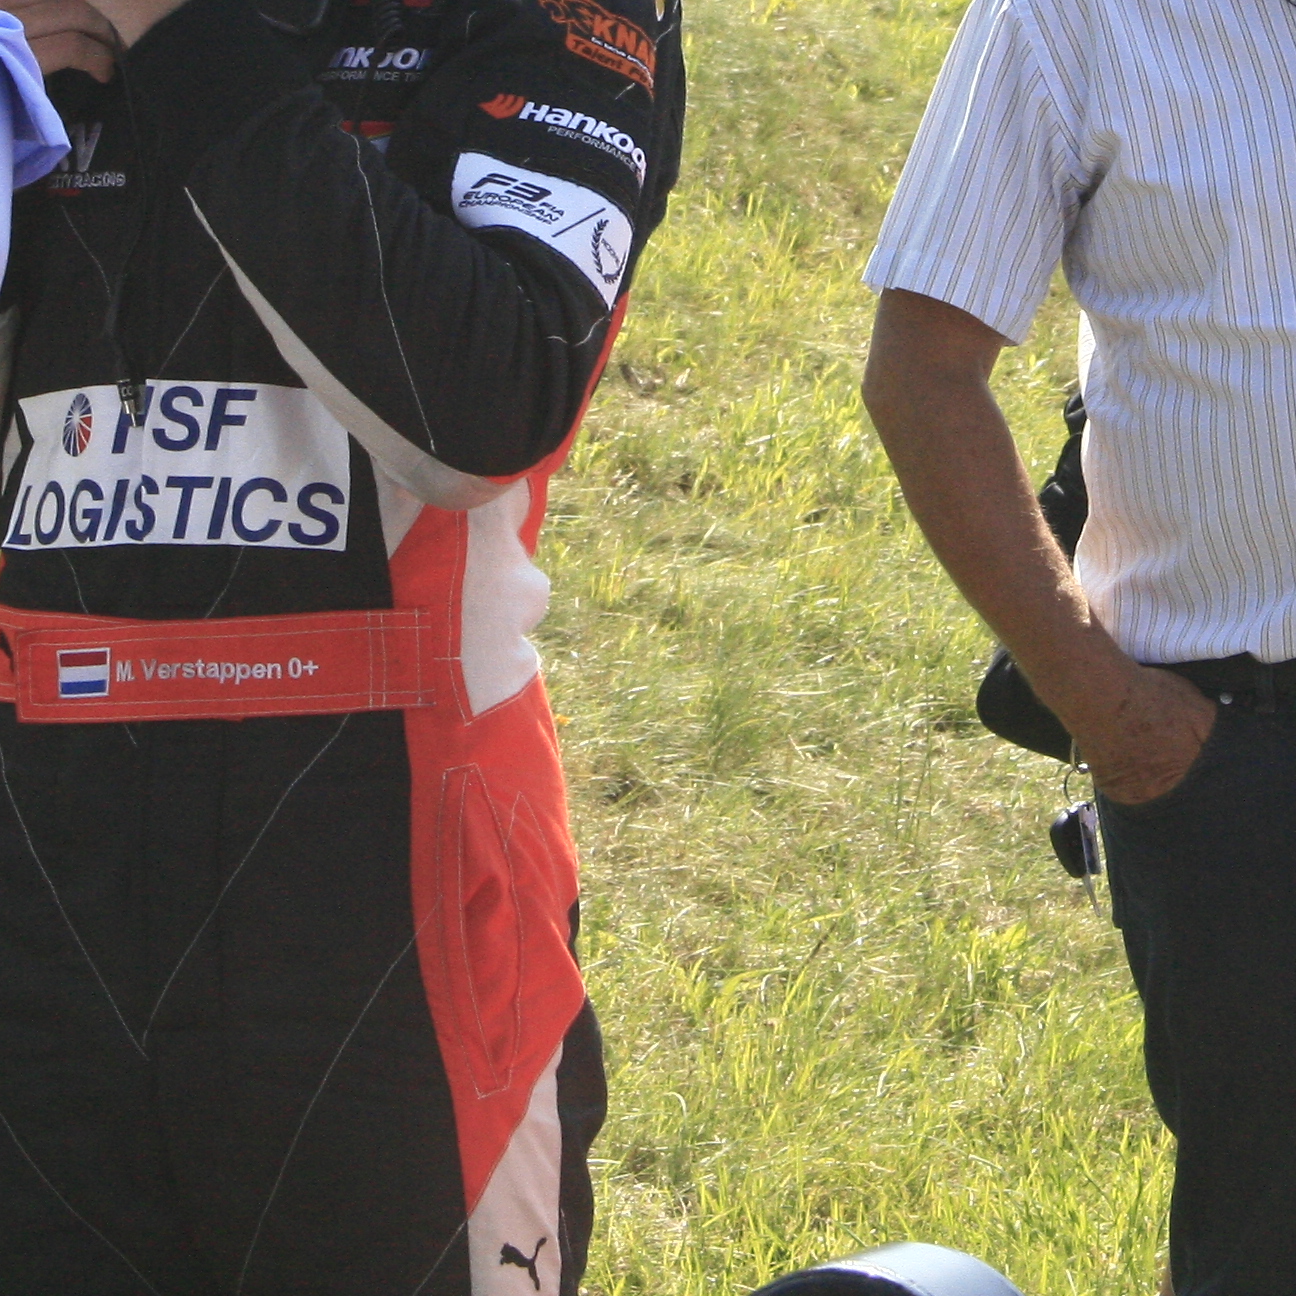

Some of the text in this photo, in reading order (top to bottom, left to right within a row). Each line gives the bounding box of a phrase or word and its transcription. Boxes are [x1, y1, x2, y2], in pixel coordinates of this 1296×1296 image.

[518, 101, 647, 190] Hankoo
[470, 173, 552, 202] F3
[463, 190, 559, 222] EUROPEAN
[539, 201, 564, 217] FIA
[5, 474, 346, 546] LOGISTICS
[140, 658, 282, 685] Verstappen
